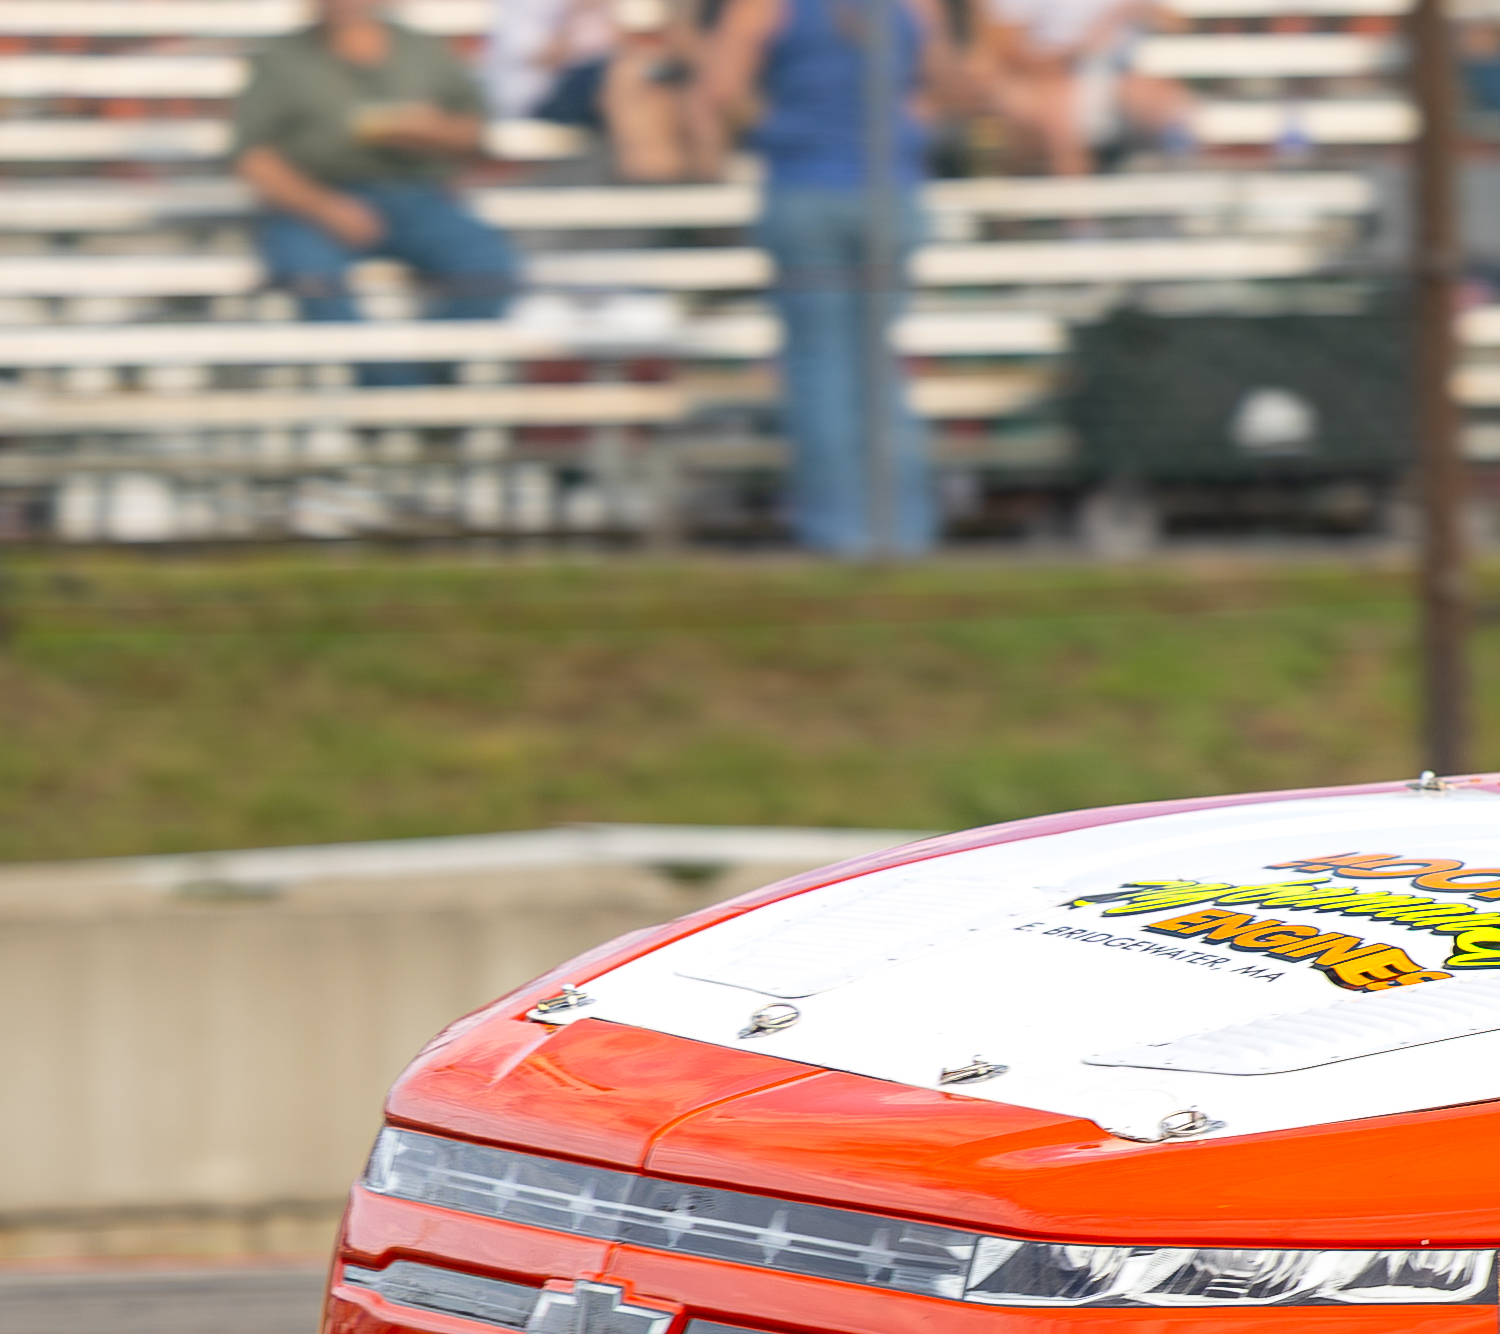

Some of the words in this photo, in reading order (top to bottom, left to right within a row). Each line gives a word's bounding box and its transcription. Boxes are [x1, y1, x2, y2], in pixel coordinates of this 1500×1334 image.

[1013, 921, 1039, 934] E.
[1042, 923, 1230, 972] BRIDGEWATER,
[1231, 964, 1287, 985] MA
